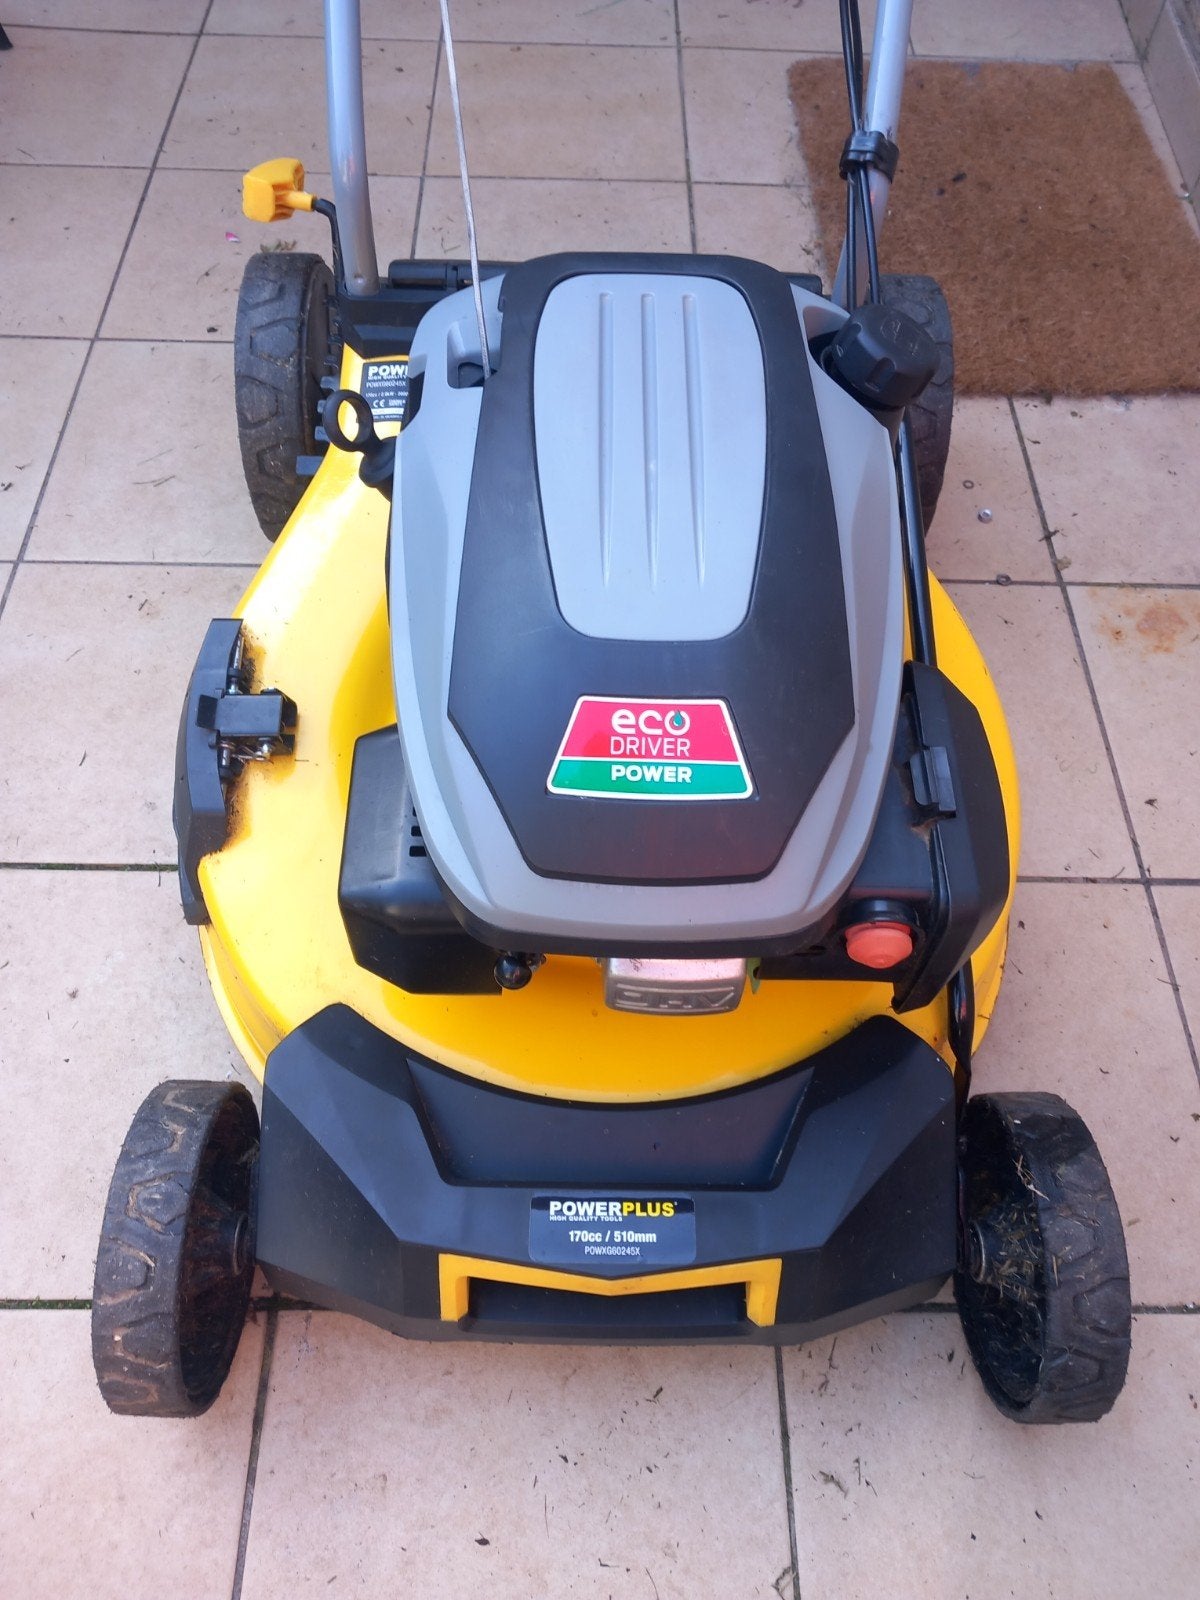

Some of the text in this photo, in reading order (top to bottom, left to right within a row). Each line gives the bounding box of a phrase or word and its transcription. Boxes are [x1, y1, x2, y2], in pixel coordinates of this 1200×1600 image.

[611, 708, 691, 736] eco
[610, 736, 691, 757] DRIVER
[611, 764, 693, 783] POWER
[568, 1230, 657, 1243] 170cc / 510mm
